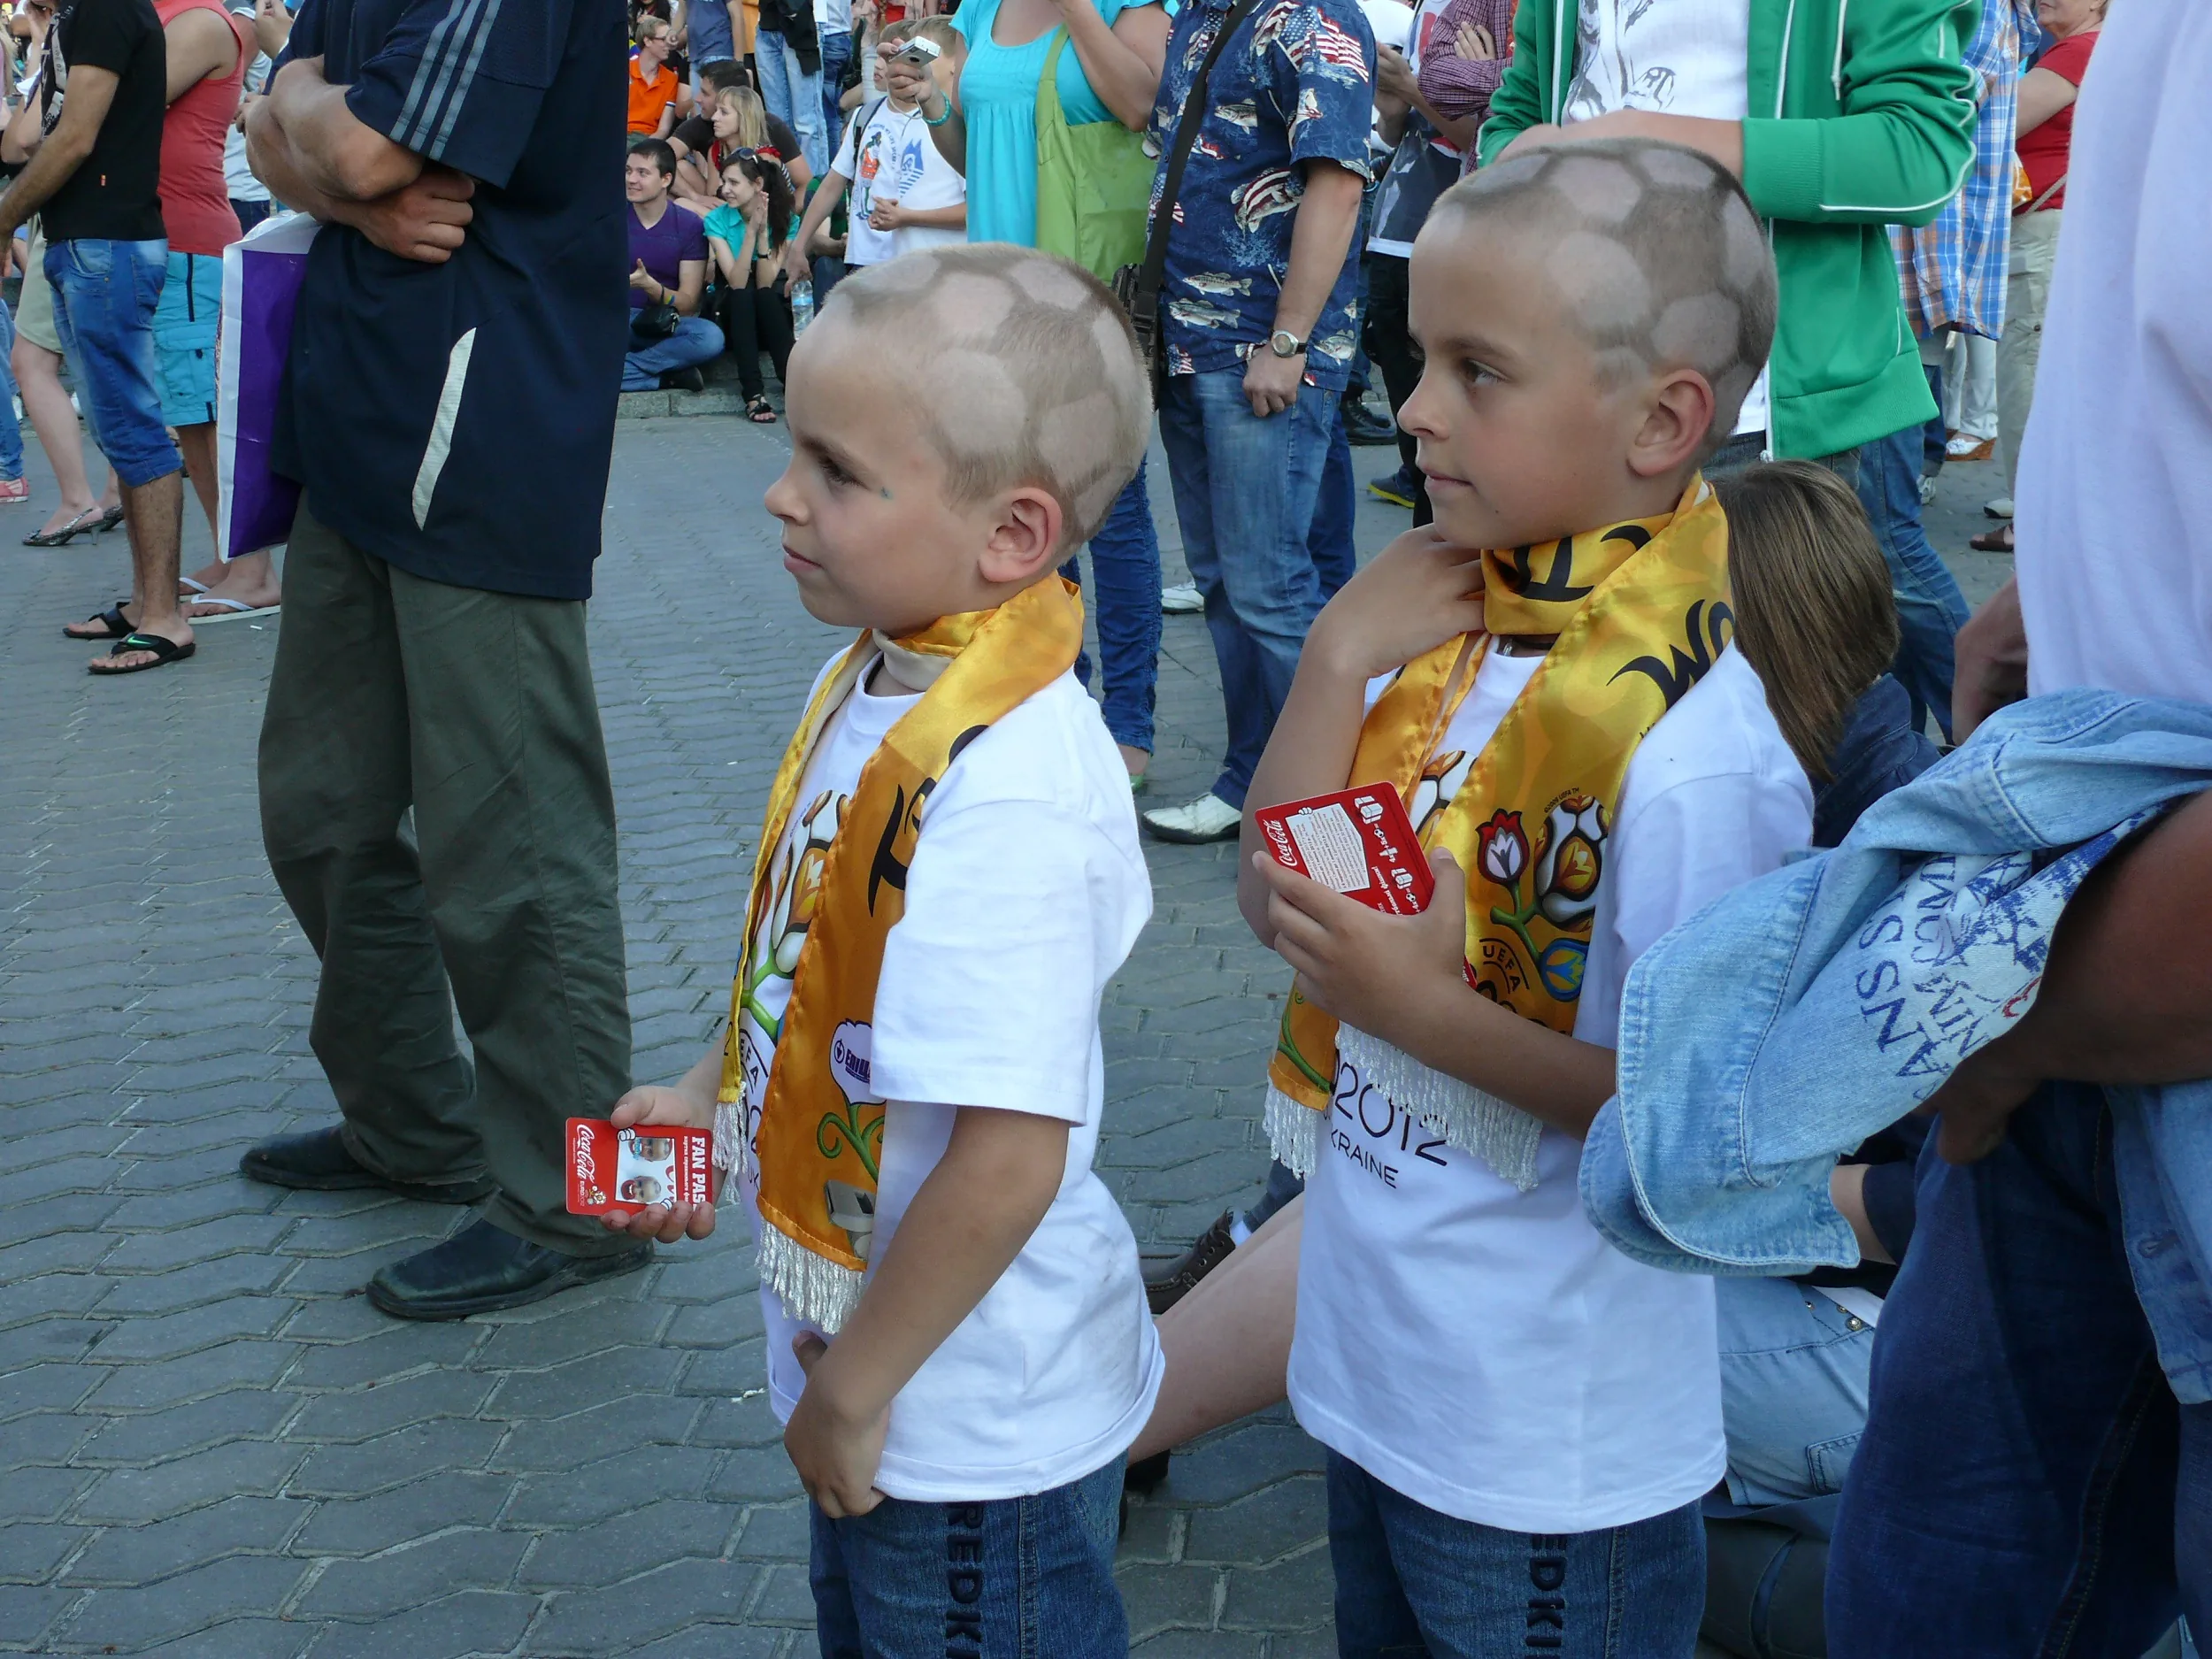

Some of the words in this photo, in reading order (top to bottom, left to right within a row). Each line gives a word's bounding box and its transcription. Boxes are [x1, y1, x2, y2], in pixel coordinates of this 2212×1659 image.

[1482, 944, 1521, 992] UEFA
[692, 1137, 705, 1169] FAN
[692, 1172, 705, 1211] PAS
